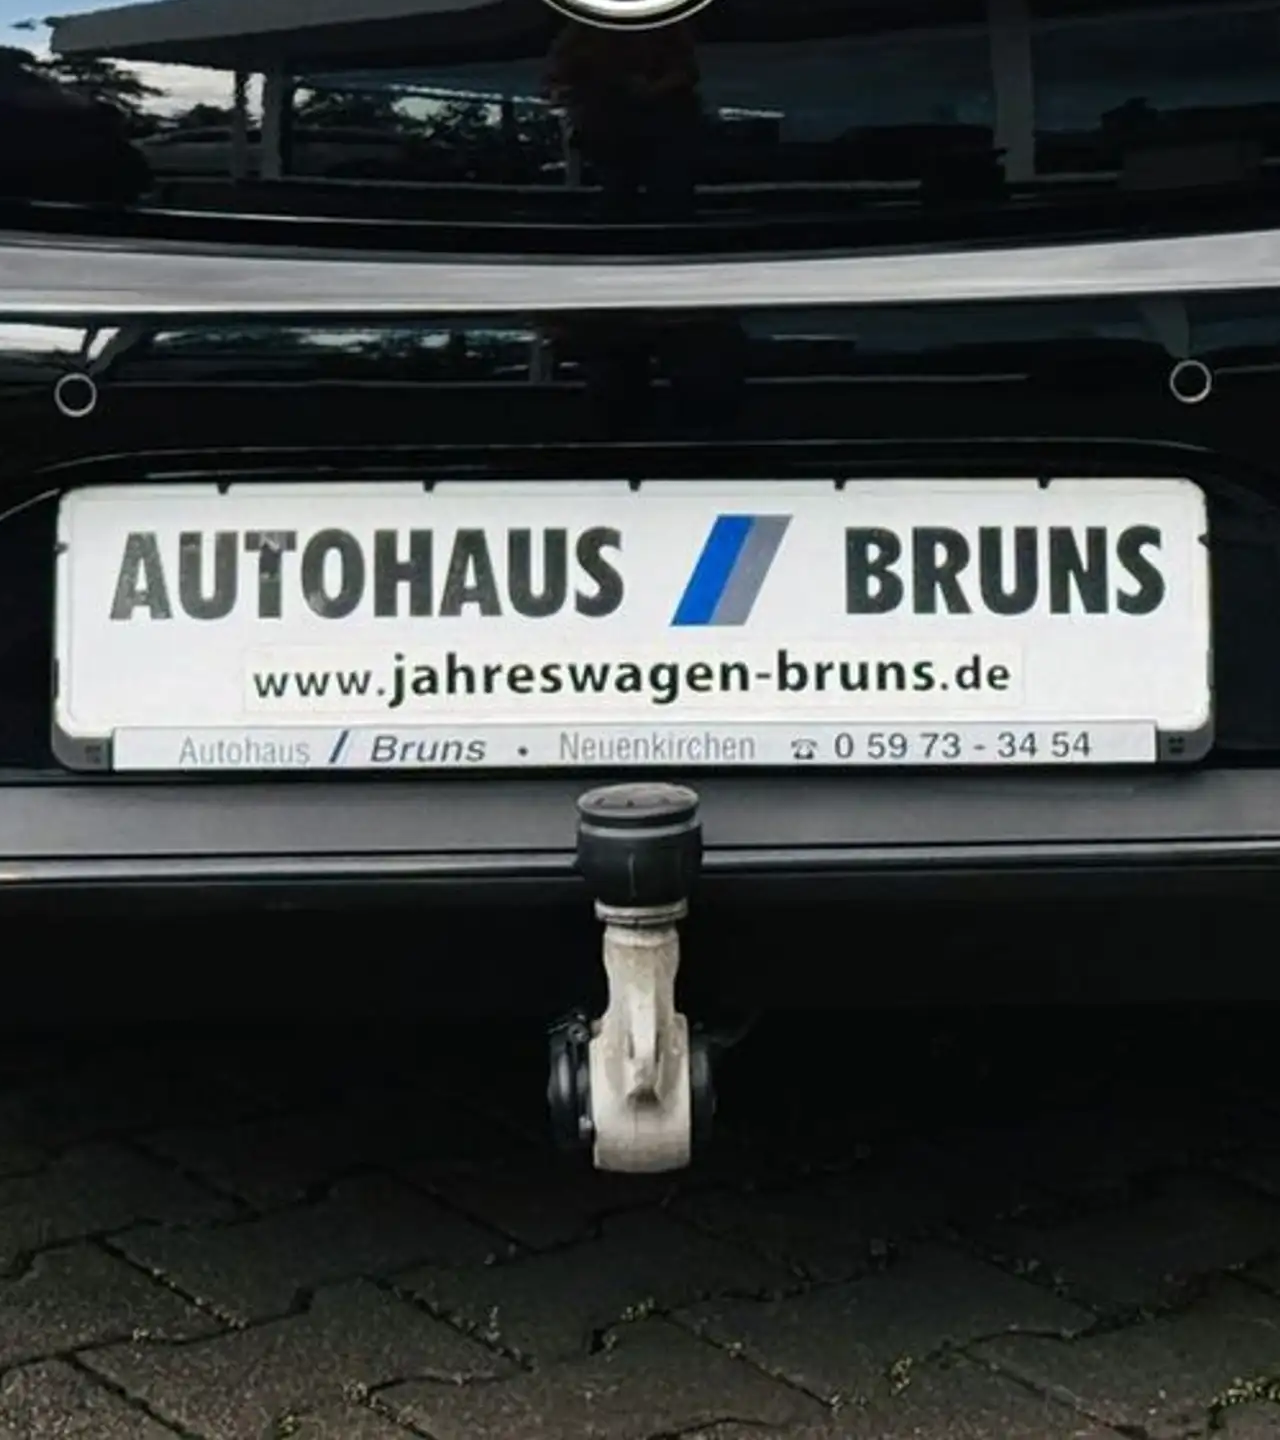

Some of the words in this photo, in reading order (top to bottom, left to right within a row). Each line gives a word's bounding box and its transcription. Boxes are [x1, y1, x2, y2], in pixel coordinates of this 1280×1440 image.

[108, 526, 624, 621] AUTOHAUS
[845, 523, 1166, 616] BRUNS
[253, 648, 1012, 708] www.jahreswagen-bruns.de
[178, 735, 311, 764] Autohaus
[370, 734, 488, 763] Bruns
[559, 731, 756, 761] Neuenkirchen
